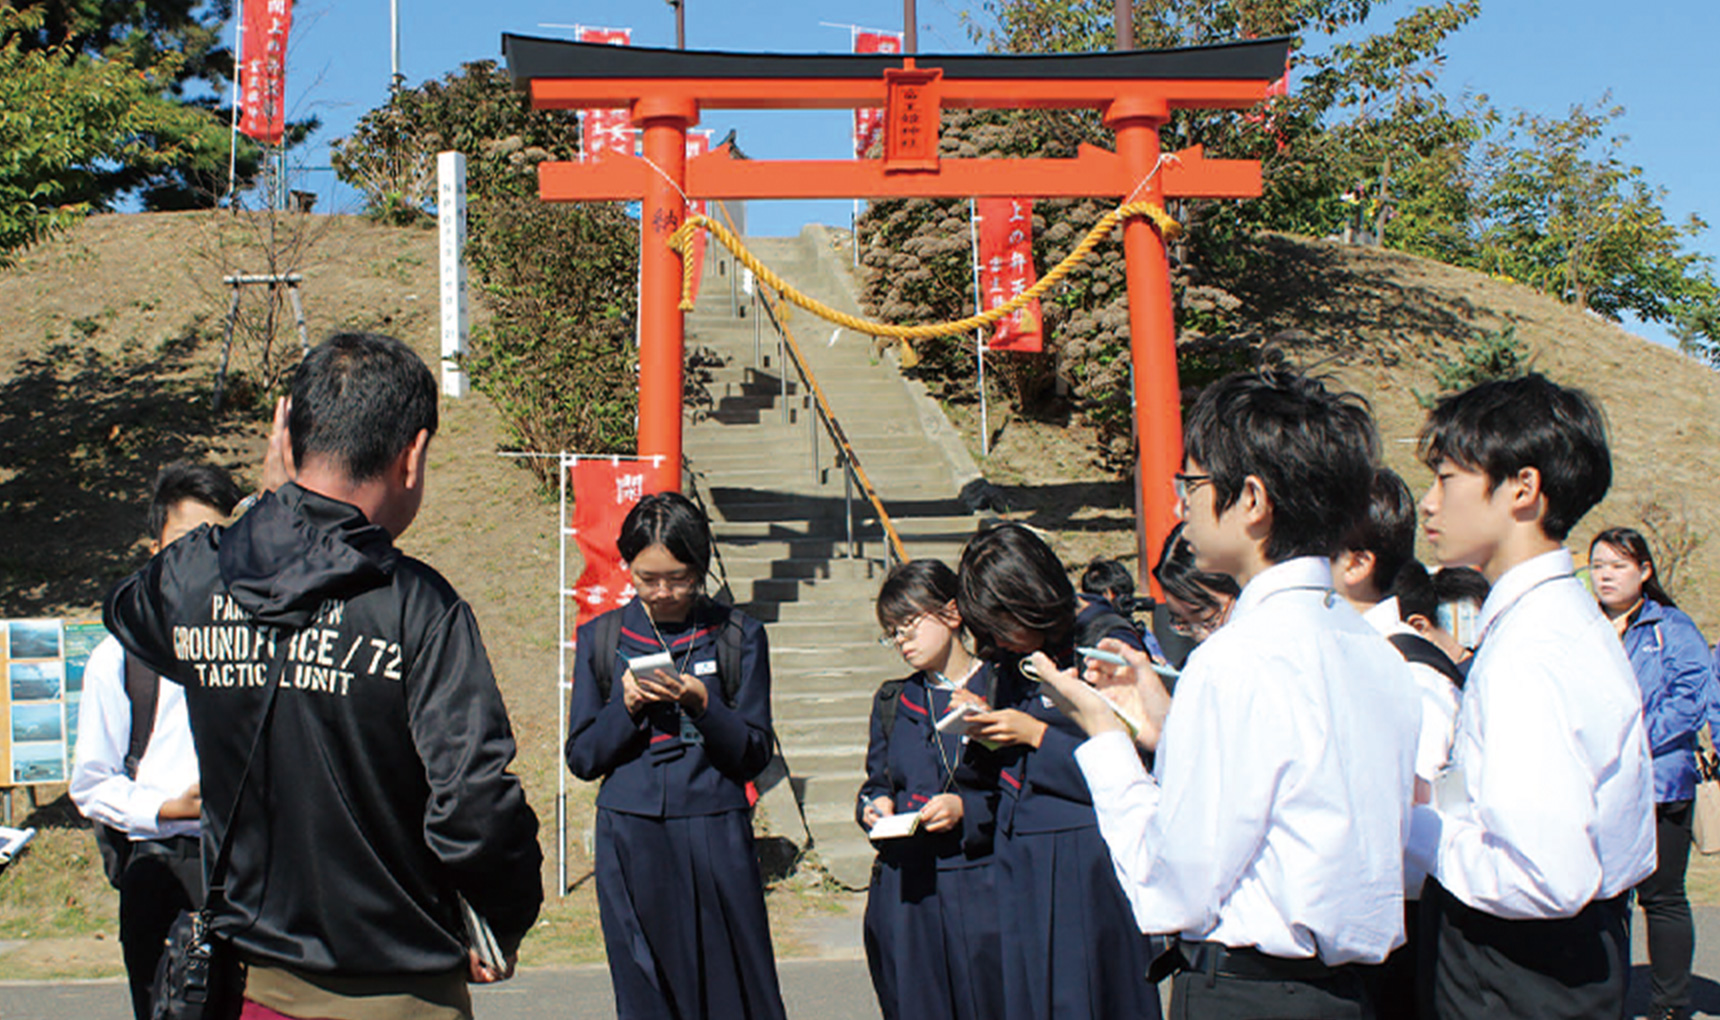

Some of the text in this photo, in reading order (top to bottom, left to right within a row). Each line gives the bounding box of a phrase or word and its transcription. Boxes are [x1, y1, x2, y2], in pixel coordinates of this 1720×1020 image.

[367, 638, 402, 681] 72
[194, 663, 355, 696] TACTICL UNIT
